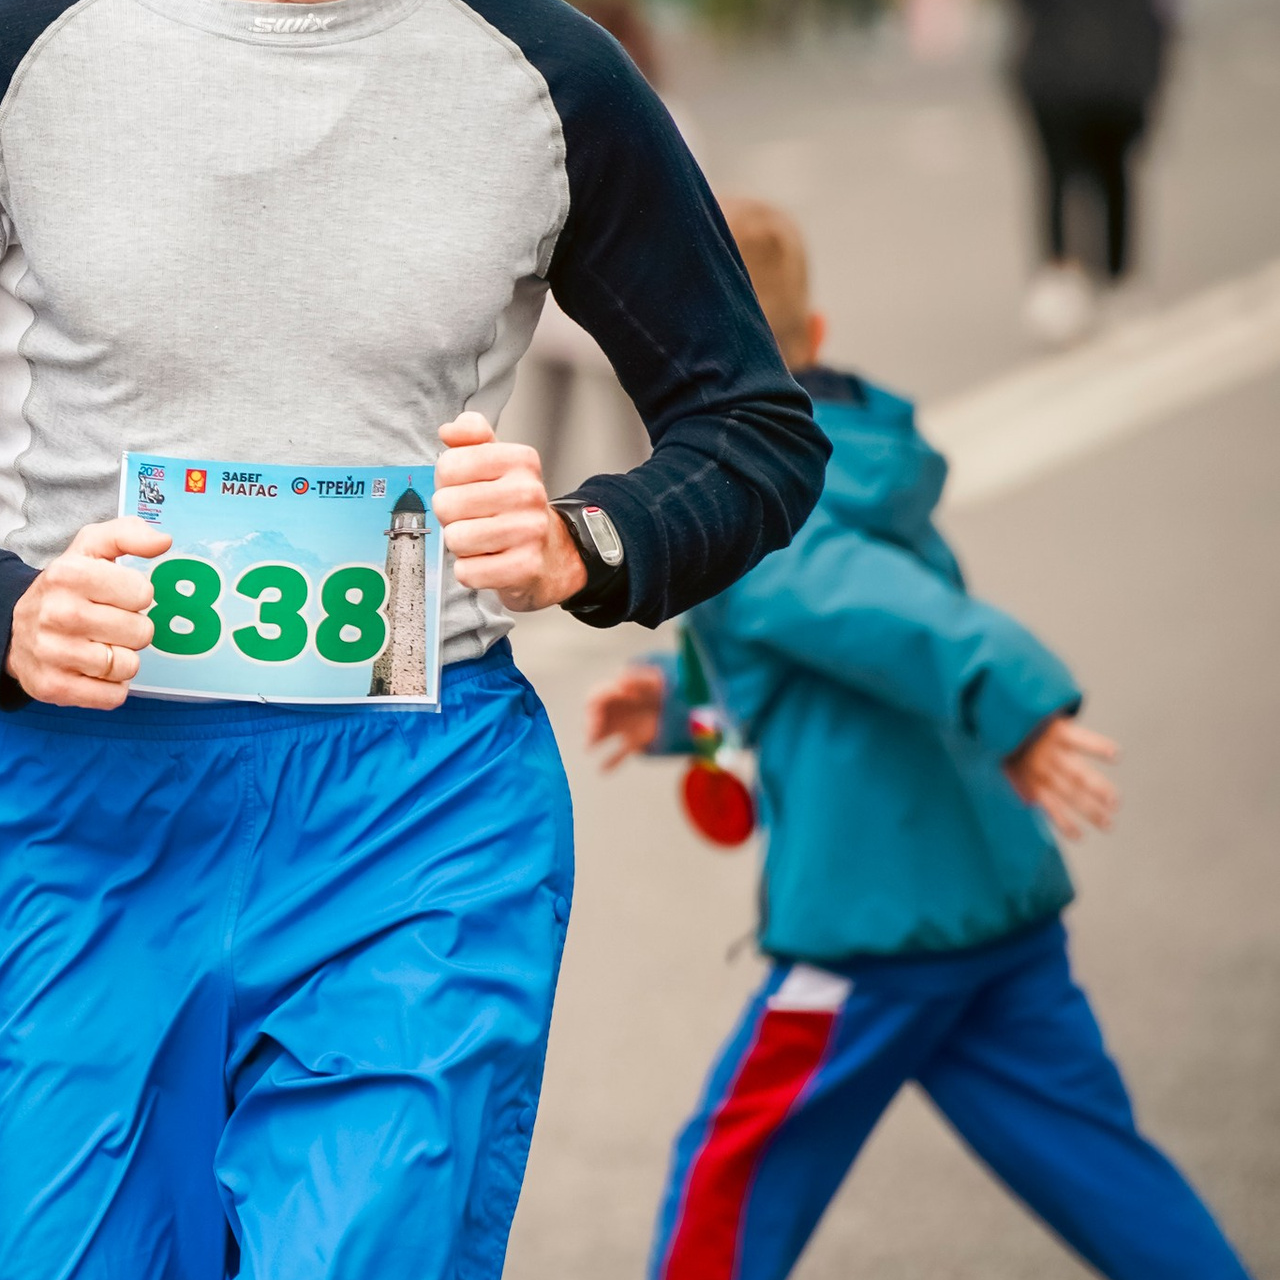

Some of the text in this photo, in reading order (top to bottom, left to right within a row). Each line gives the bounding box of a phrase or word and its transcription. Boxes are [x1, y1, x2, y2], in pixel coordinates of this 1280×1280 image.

[248, 13, 337, 33] swix
[140, 466, 165, 478] 2026
[222, 471, 262, 483] ЗАБЕГ
[221, 482, 278, 498] МАГАС
[147, 558, 386, 664] 838
